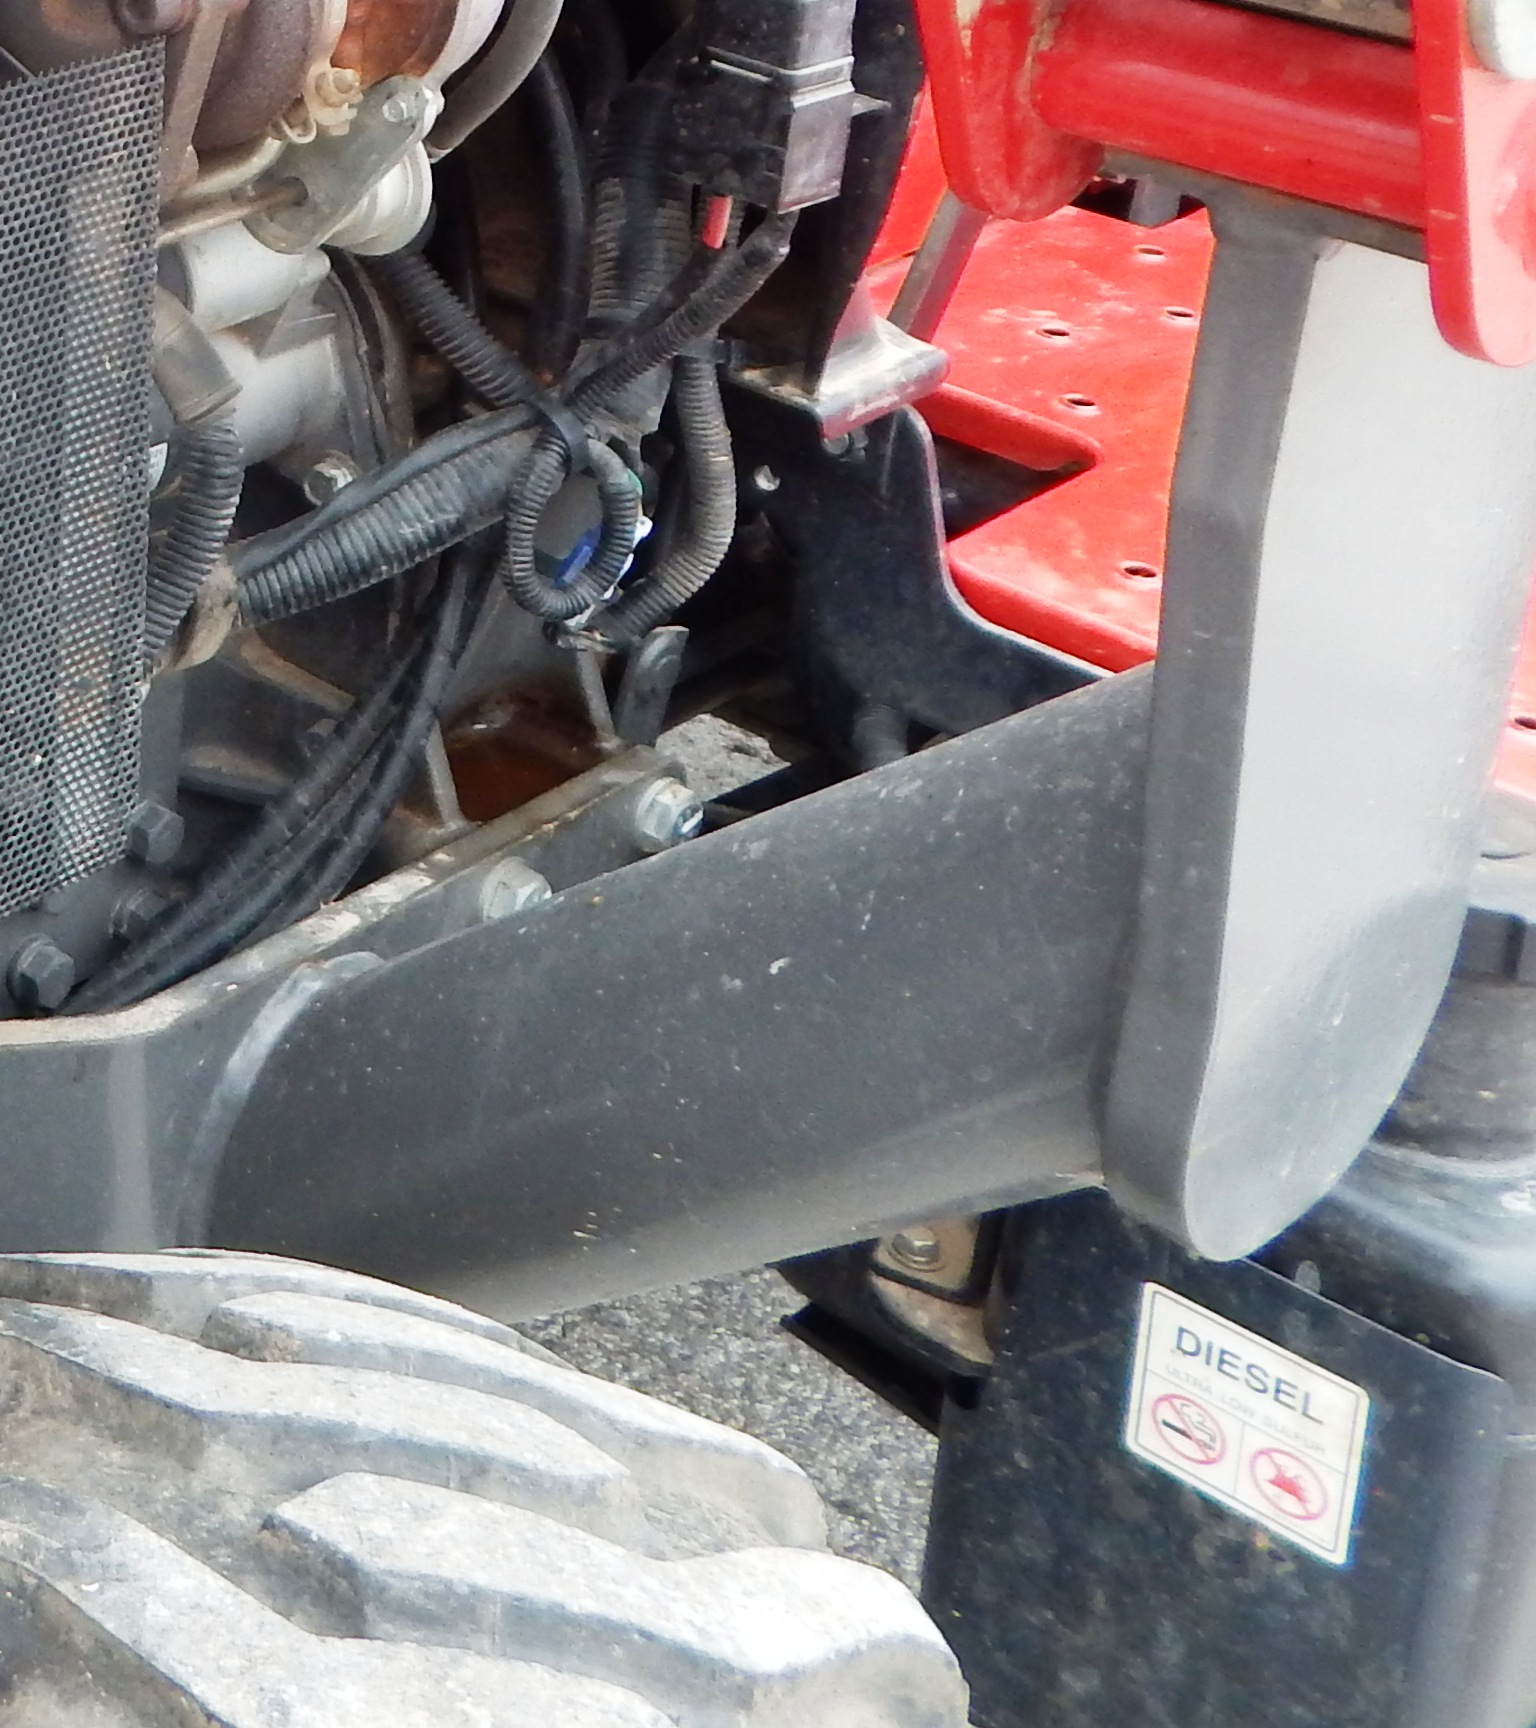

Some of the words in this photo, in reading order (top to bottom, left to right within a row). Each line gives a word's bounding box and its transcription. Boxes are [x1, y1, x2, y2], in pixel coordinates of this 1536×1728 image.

[1165, 1363, 1212, 1395] ULTRA
[1220, 1392, 1257, 1420] LOW
[1263, 1413, 1325, 1456] SULFUR
[1175, 1325, 1324, 1425] DIESEL
